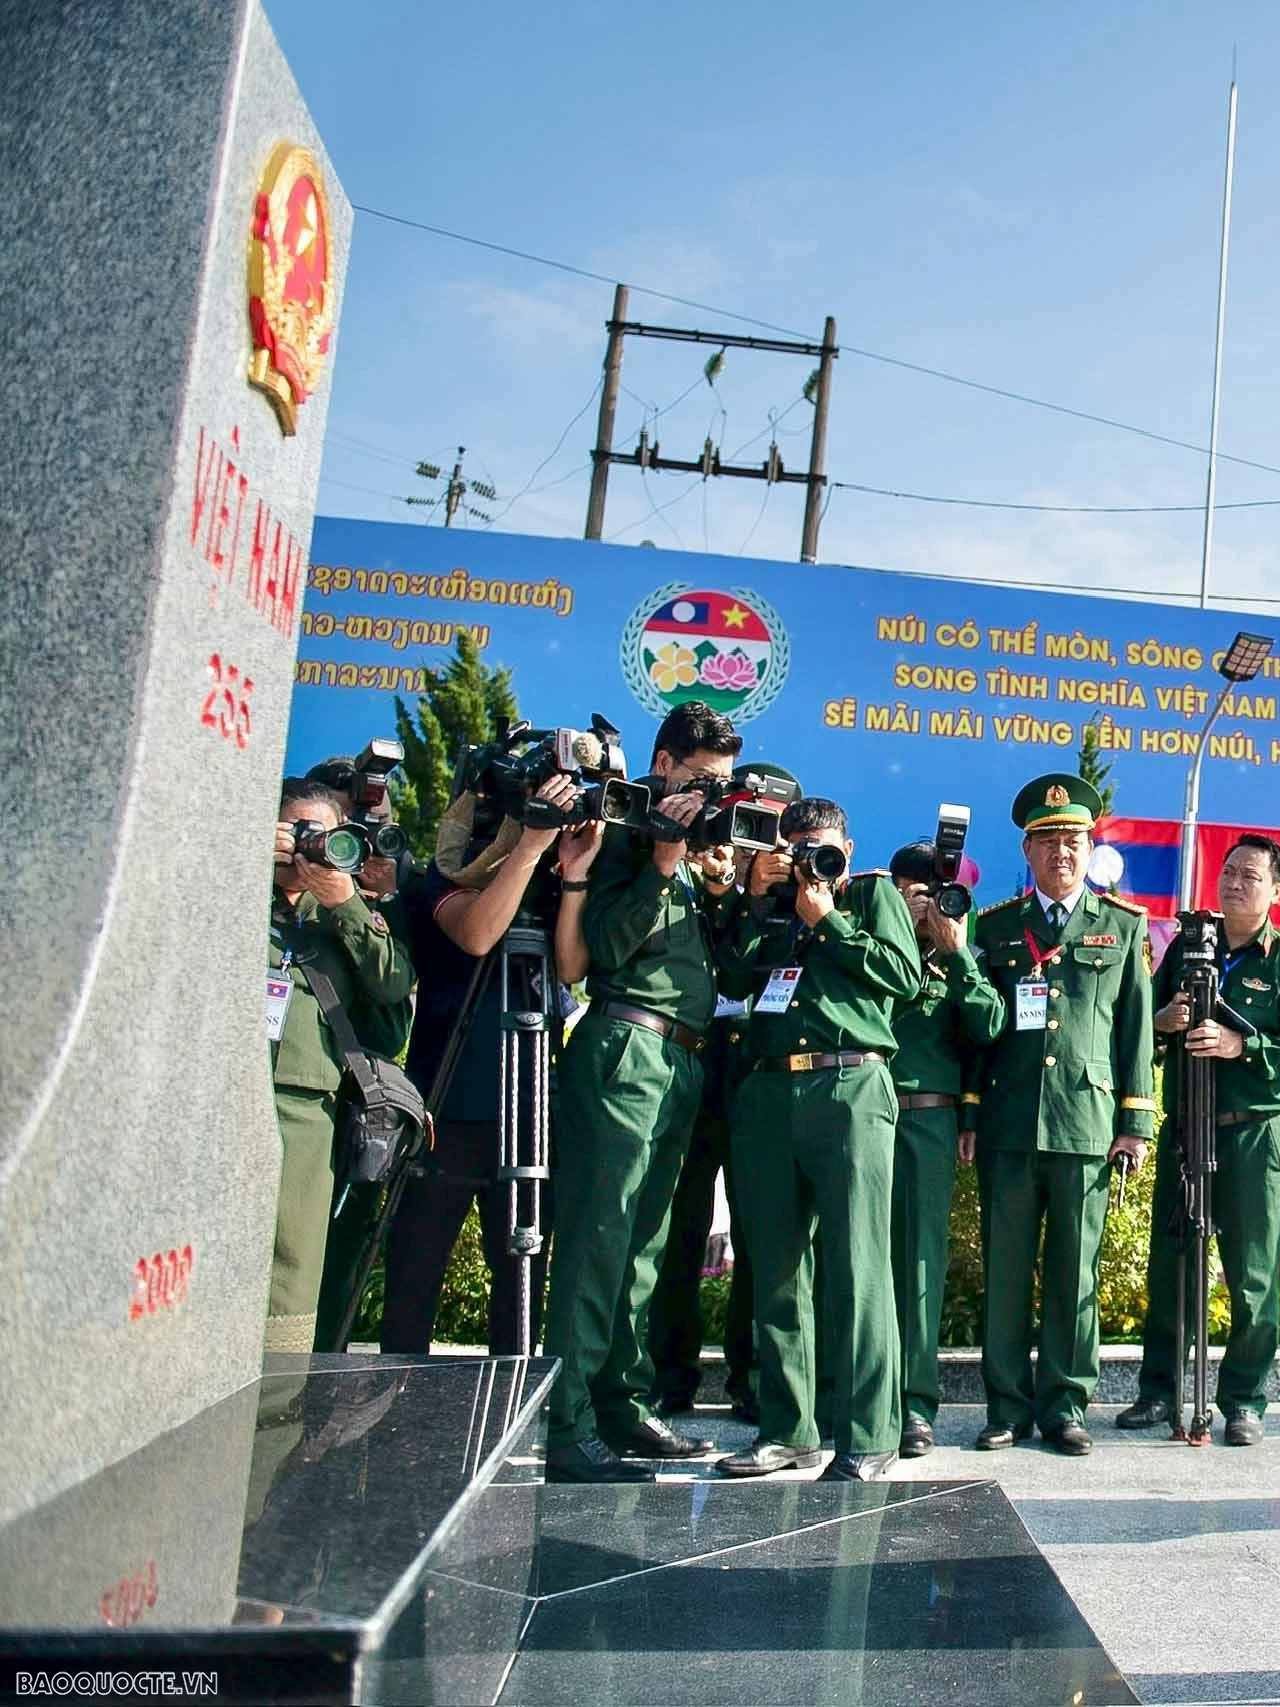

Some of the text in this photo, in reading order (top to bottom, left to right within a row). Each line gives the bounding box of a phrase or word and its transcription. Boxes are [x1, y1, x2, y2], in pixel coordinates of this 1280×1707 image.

[877, 613, 926, 644] NÚI
[935, 620, 981, 649] CÓ
[988, 621, 1039, 656] THỂ
[1044, 631, 1117, 667] MÒN,
[1126, 639, 1203, 671] SÔNG
[894, 663, 978, 693] SONG
[986, 667, 1049, 699] TÌNH
[1057, 678, 1147, 709] NGHĨA
[1155, 684, 1209, 720] VIỆT
[1217, 692, 1277, 720] NAM
[824, 698, 857, 728] SẼ
[865, 702, 921, 734] MÃI
[929, 708, 984, 739] MÃI
[993, 713, 1073, 746] VỮNG
[1140, 727, 1201, 755] HƠN
[1208, 732, 1262, 765] NÚI,
